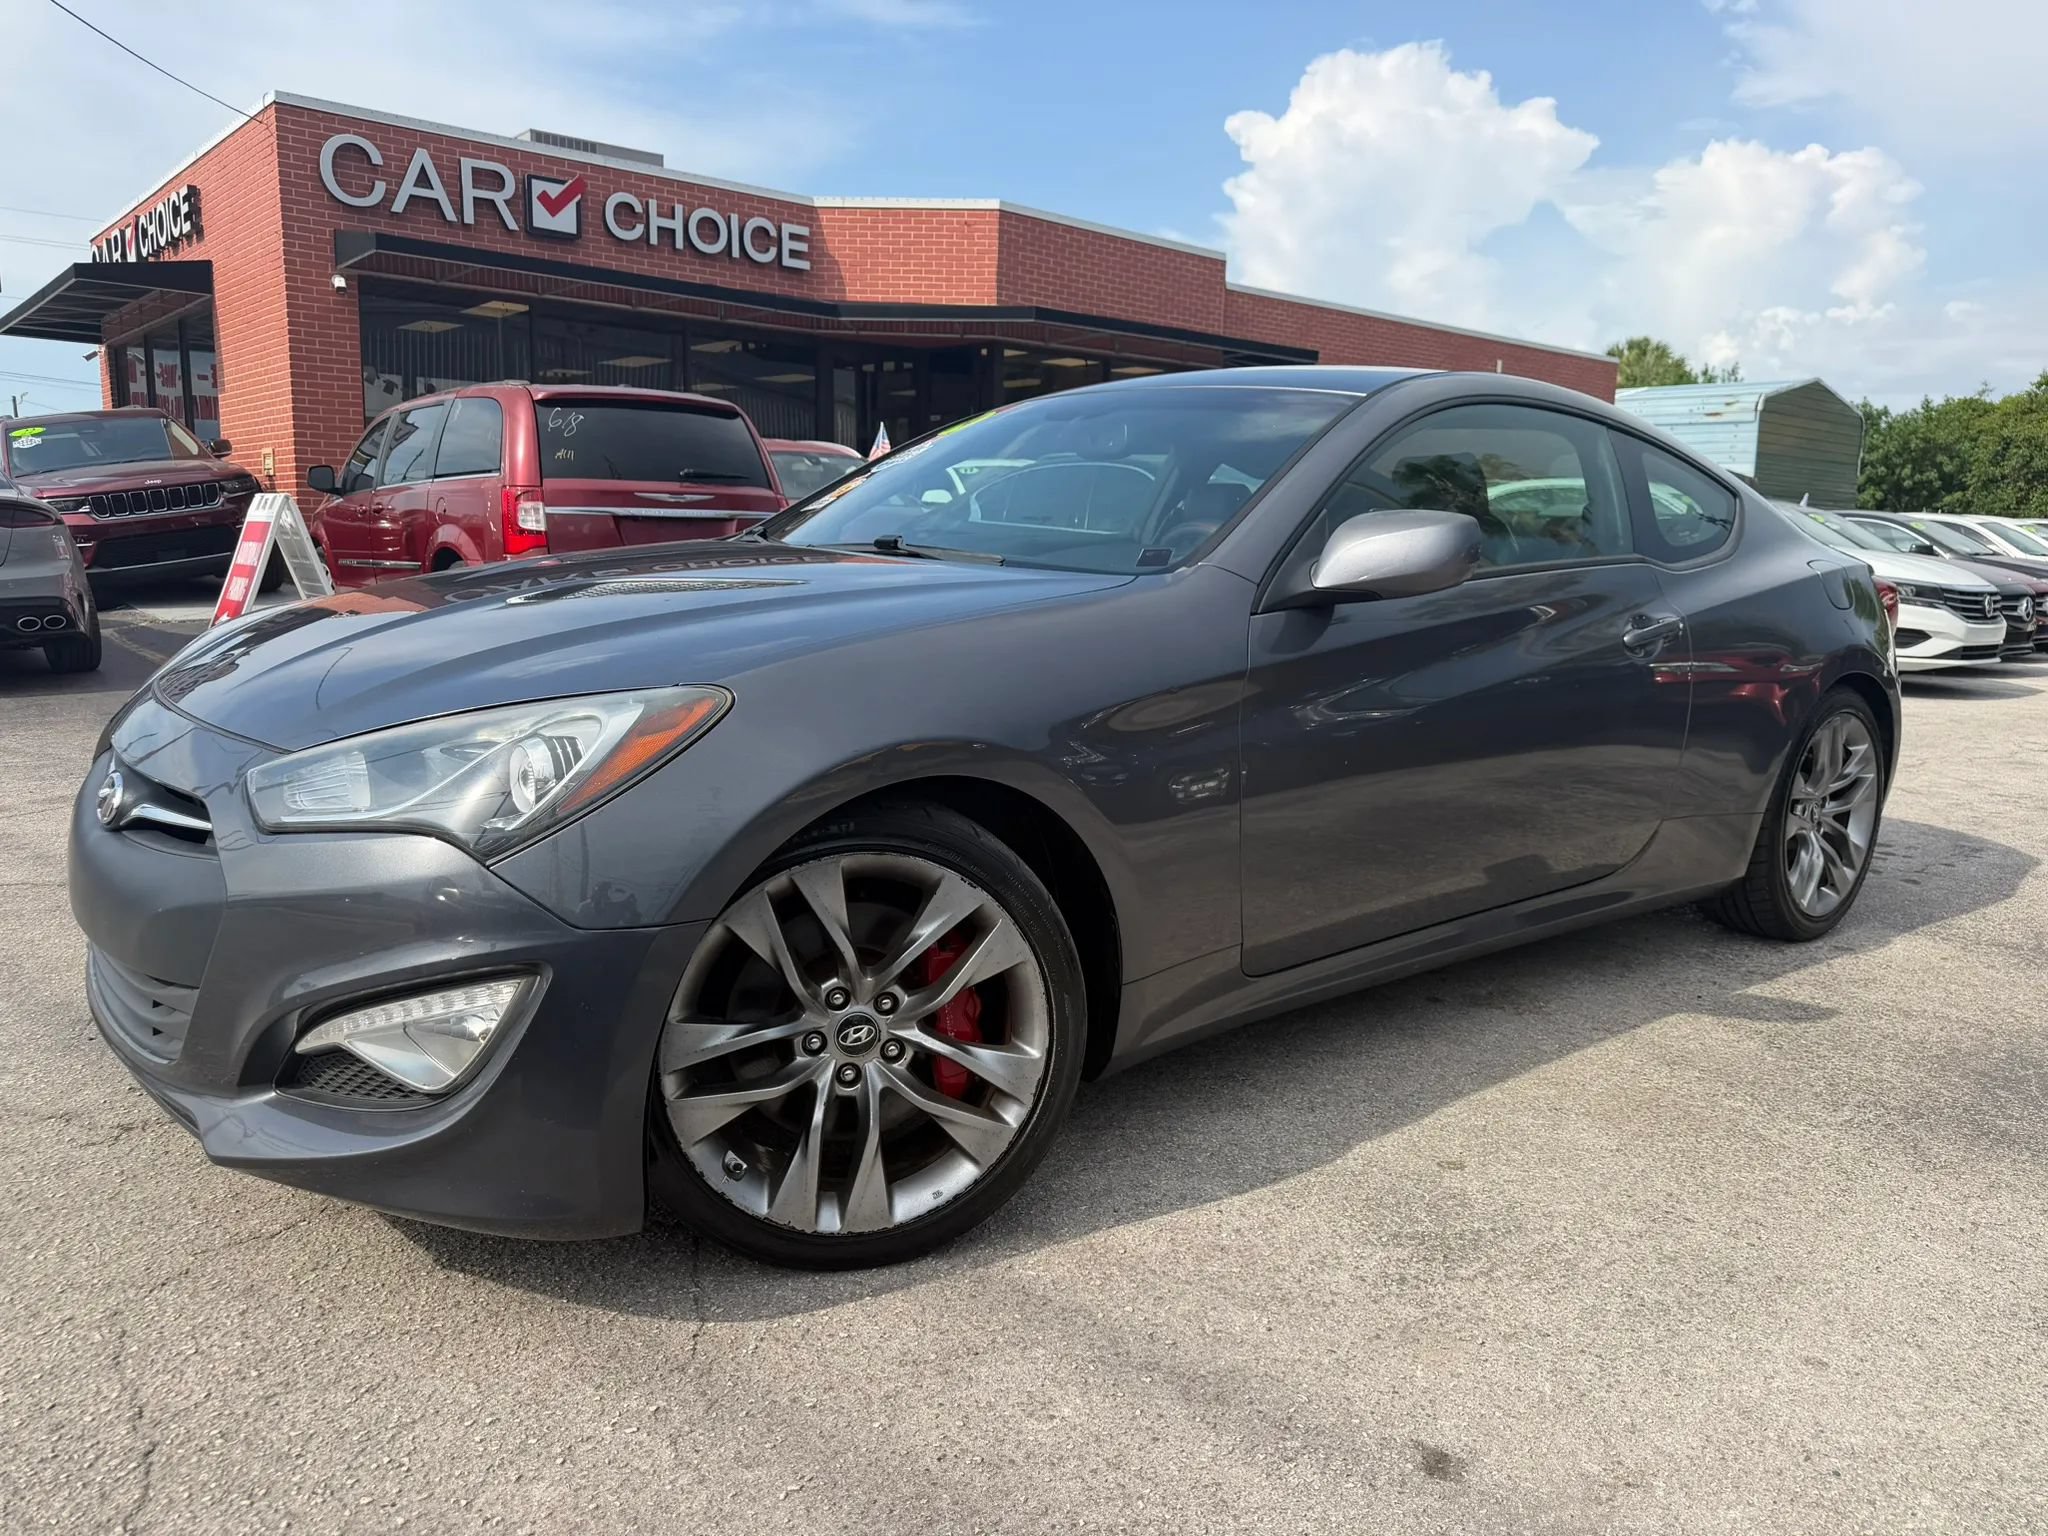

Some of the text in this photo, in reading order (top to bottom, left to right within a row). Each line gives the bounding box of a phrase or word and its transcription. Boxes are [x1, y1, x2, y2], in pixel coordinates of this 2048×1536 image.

[138, 183, 193, 258] CHOICE
[318, 133, 812, 271] CAR CHOICE
